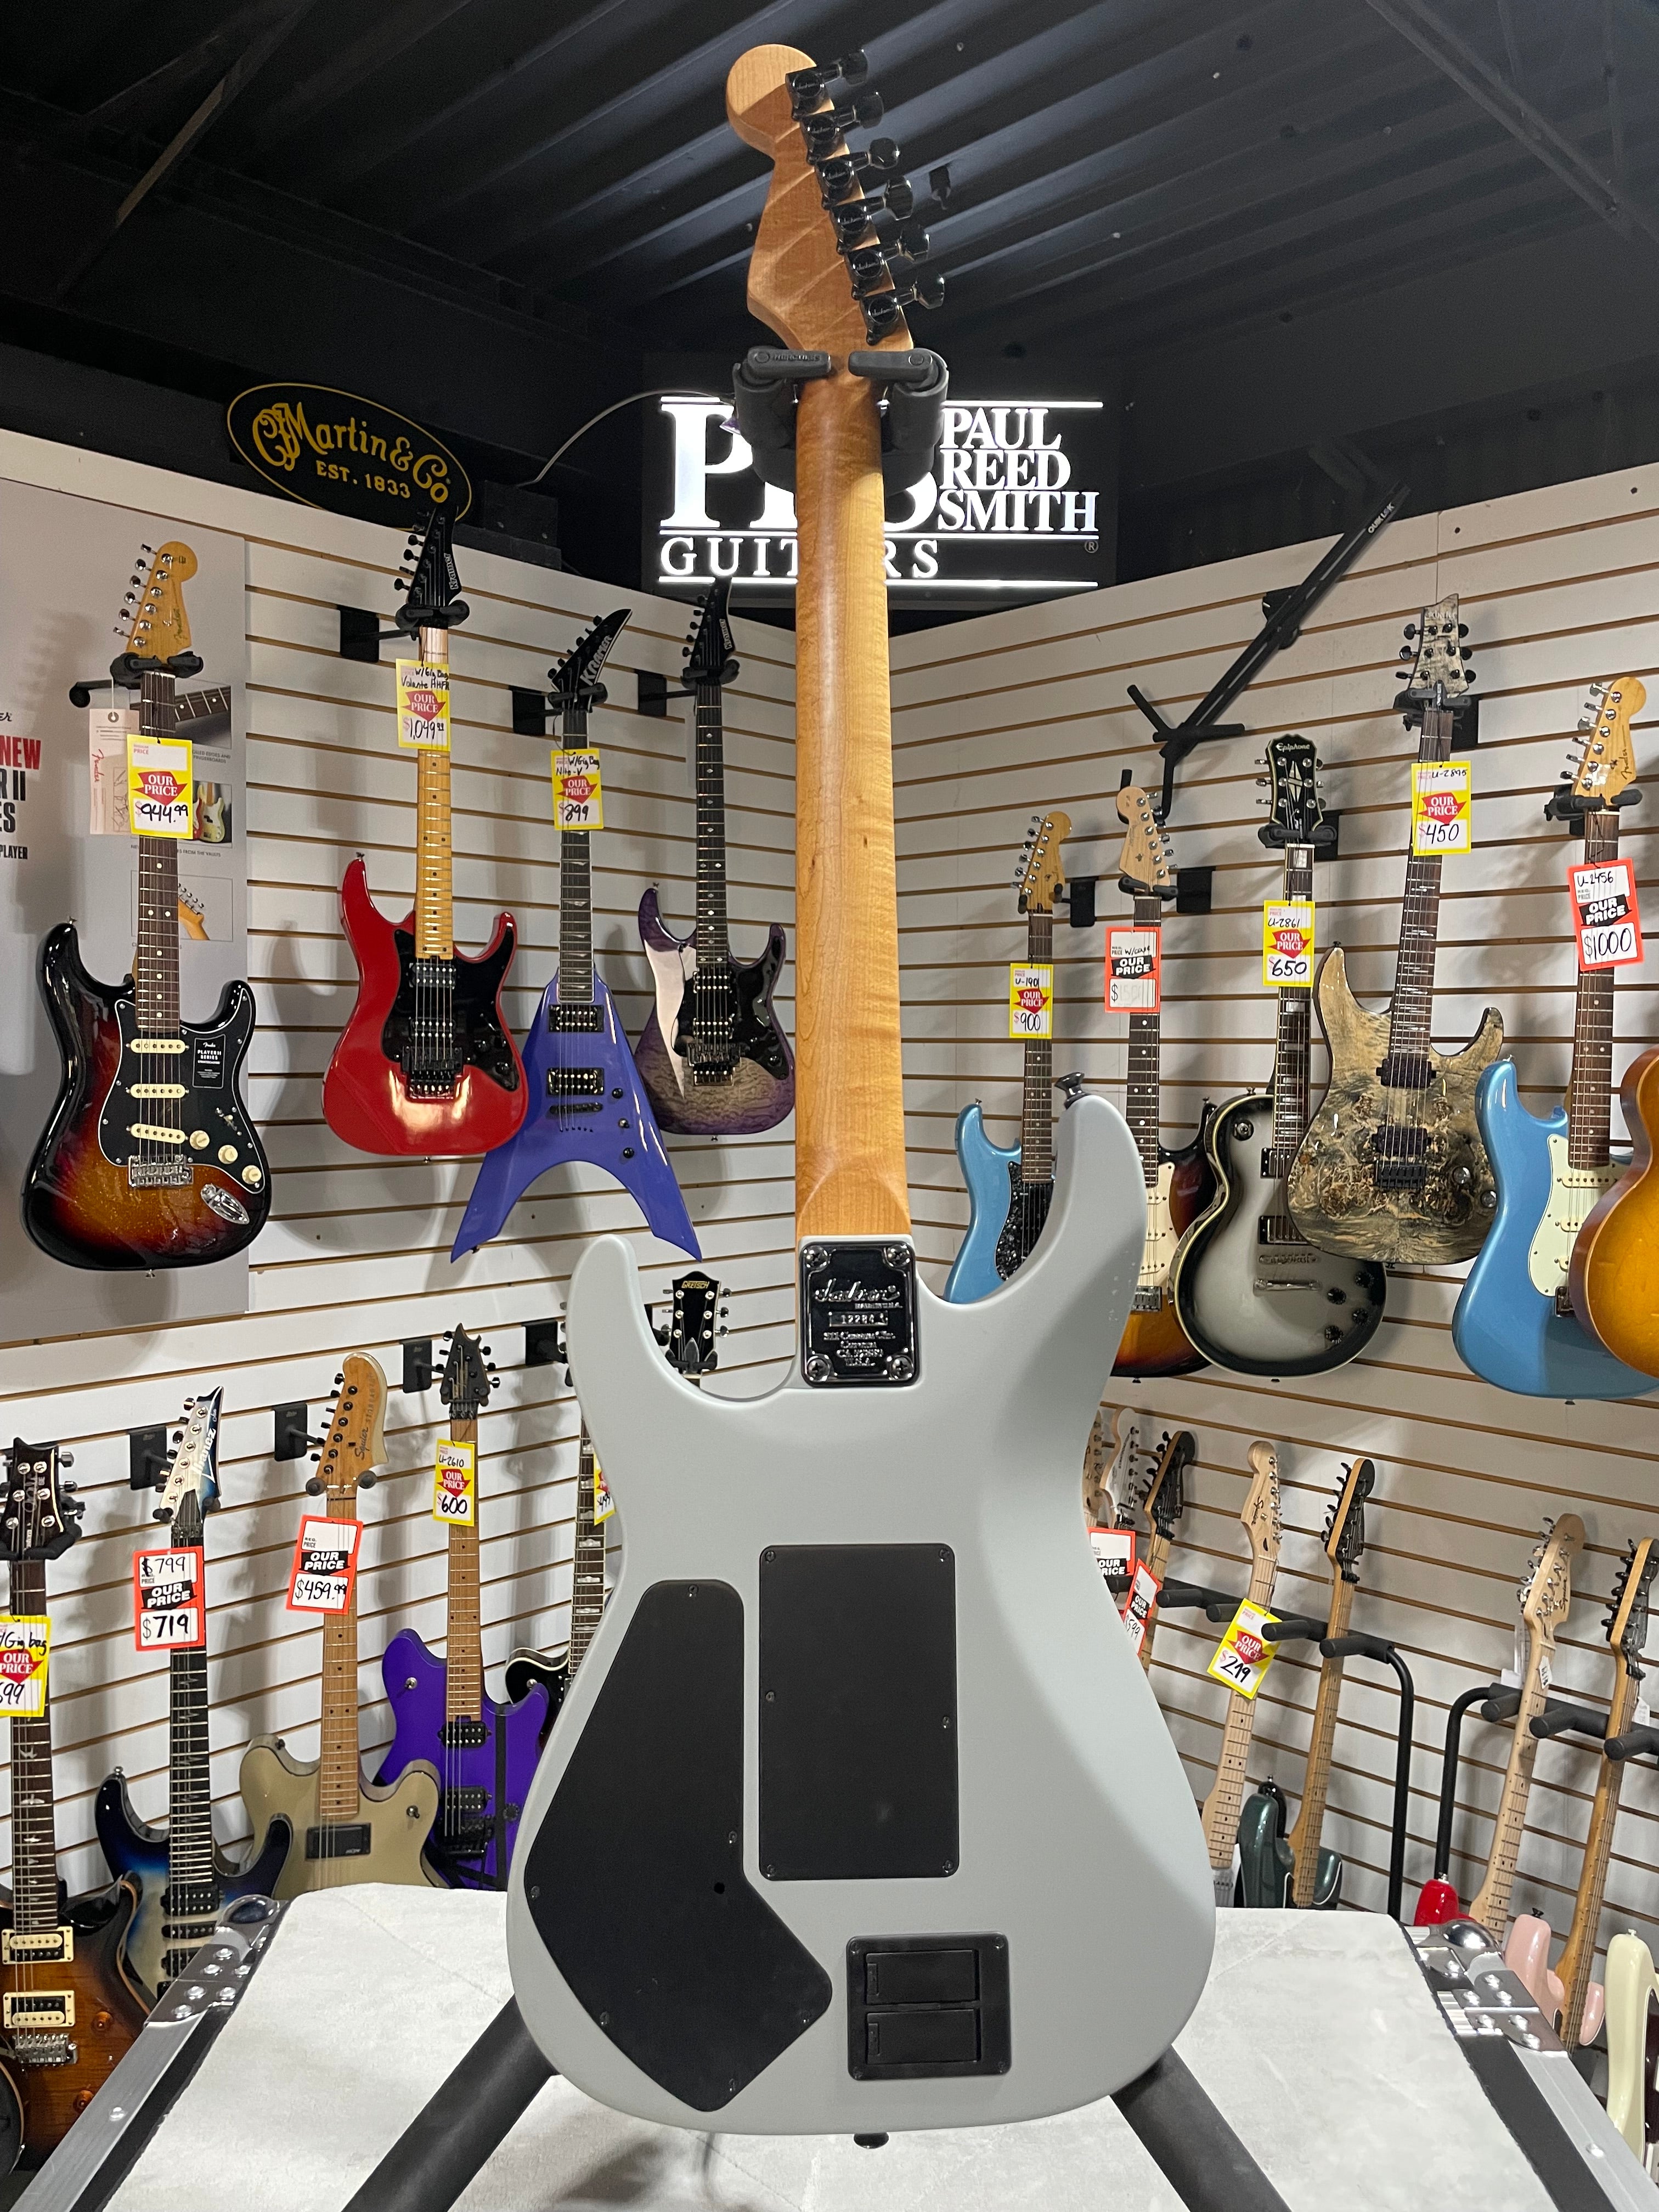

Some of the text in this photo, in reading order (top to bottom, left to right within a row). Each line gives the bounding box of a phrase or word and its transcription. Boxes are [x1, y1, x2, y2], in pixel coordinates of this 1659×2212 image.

[941, 407, 1062, 450] PAUL
[939, 448, 1071, 490] REED
[316, 460, 411, 499] EST. 1833
[938, 489, 1100, 532] SMITH
[660, 537, 939, 579] GUITRS
[443, 552, 459, 590] Kramer
[719, 618, 732, 650] Kramer
[414, 693, 435, 704] OUR
[411, 702, 439, 714] PRICE
[0, 735, 42, 770] NEW
[1275, 742, 1311, 753] Epiphone
[148, 774, 173, 786] OUR
[568, 778, 588, 788] OUR
[144, 784, 178, 797] PRICE
[565, 786, 591, 797] PRICE
[1431, 796, 1454, 806] OUR
[1427, 805, 1458, 816] PRICE
[1419, 823, 1459, 845] $450
[1588, 897, 1618, 914] OUR
[1585, 905, 1626, 926] PRICE
[1280, 932, 1300, 941] OUR
[1277, 941, 1304, 951] PRICE
[1584, 928, 1632, 961] $1000
[1119, 956, 1144, 968] OUR
[1115, 963, 1151, 976] PRICE
[1024, 991, 1041, 999] OUR
[1021, 998, 1043, 1007] PRICE
[1014, 1012, 1041, 1032] $900
[681, 1280, 710, 1289] GRETSCH
[354, 1426, 370, 1462] Squier
[191, 1427, 217, 1475] Ibanez
[445, 1471, 462, 1481] OUR
[443, 1478, 466, 1491] PRICE
[437, 1492, 467, 1514] $600
[310, 1551, 340, 1562] OUR
[304, 1560, 345, 1571] PRICE
[1098, 1559, 1121, 1568] OUR
[1101, 1566, 1126, 1576] RICE
[151, 1583, 183, 1597] OUR
[147, 1590, 191, 1609] PRICE
[1134, 1595, 1148, 1610] OUR
[1131, 1600, 1148, 1618] PRICE
[142, 1613, 189, 1641] $719
[1241, 1635, 1262, 1652] OUR
[1234, 1641, 1261, 1661] PRICE
[3, 1652, 30, 1664] OUR
[0, 1663, 34, 1674] PRICE
